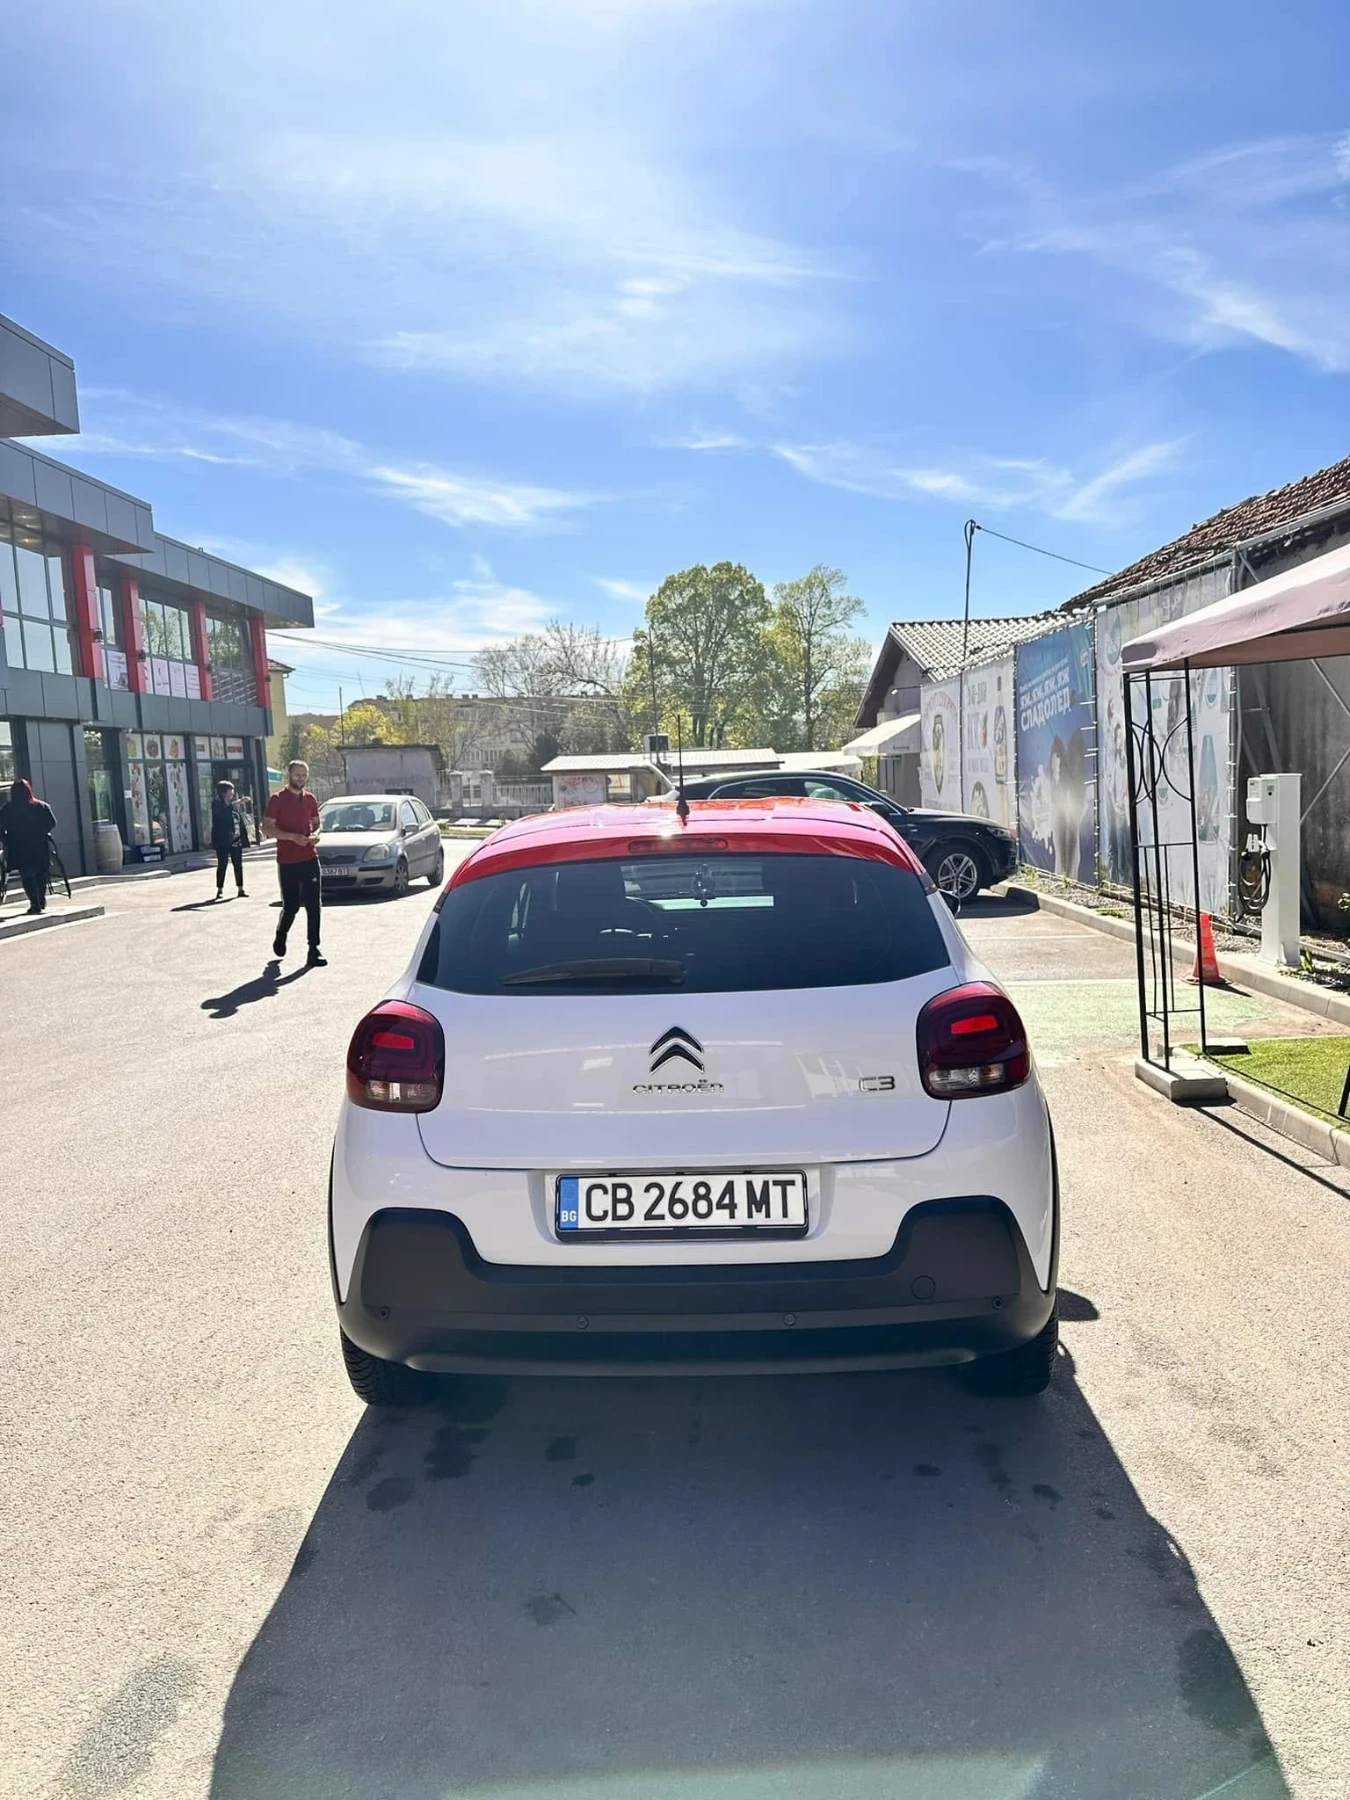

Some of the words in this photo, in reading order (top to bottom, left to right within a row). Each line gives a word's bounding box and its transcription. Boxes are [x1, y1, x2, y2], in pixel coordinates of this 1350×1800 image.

[859, 1076, 895, 1092] C3
[585, 1183, 634, 1222] CB
[643, 1180, 738, 1221] 2684
[746, 1180, 796, 1219] MT
[561, 1211, 577, 1222] BG
